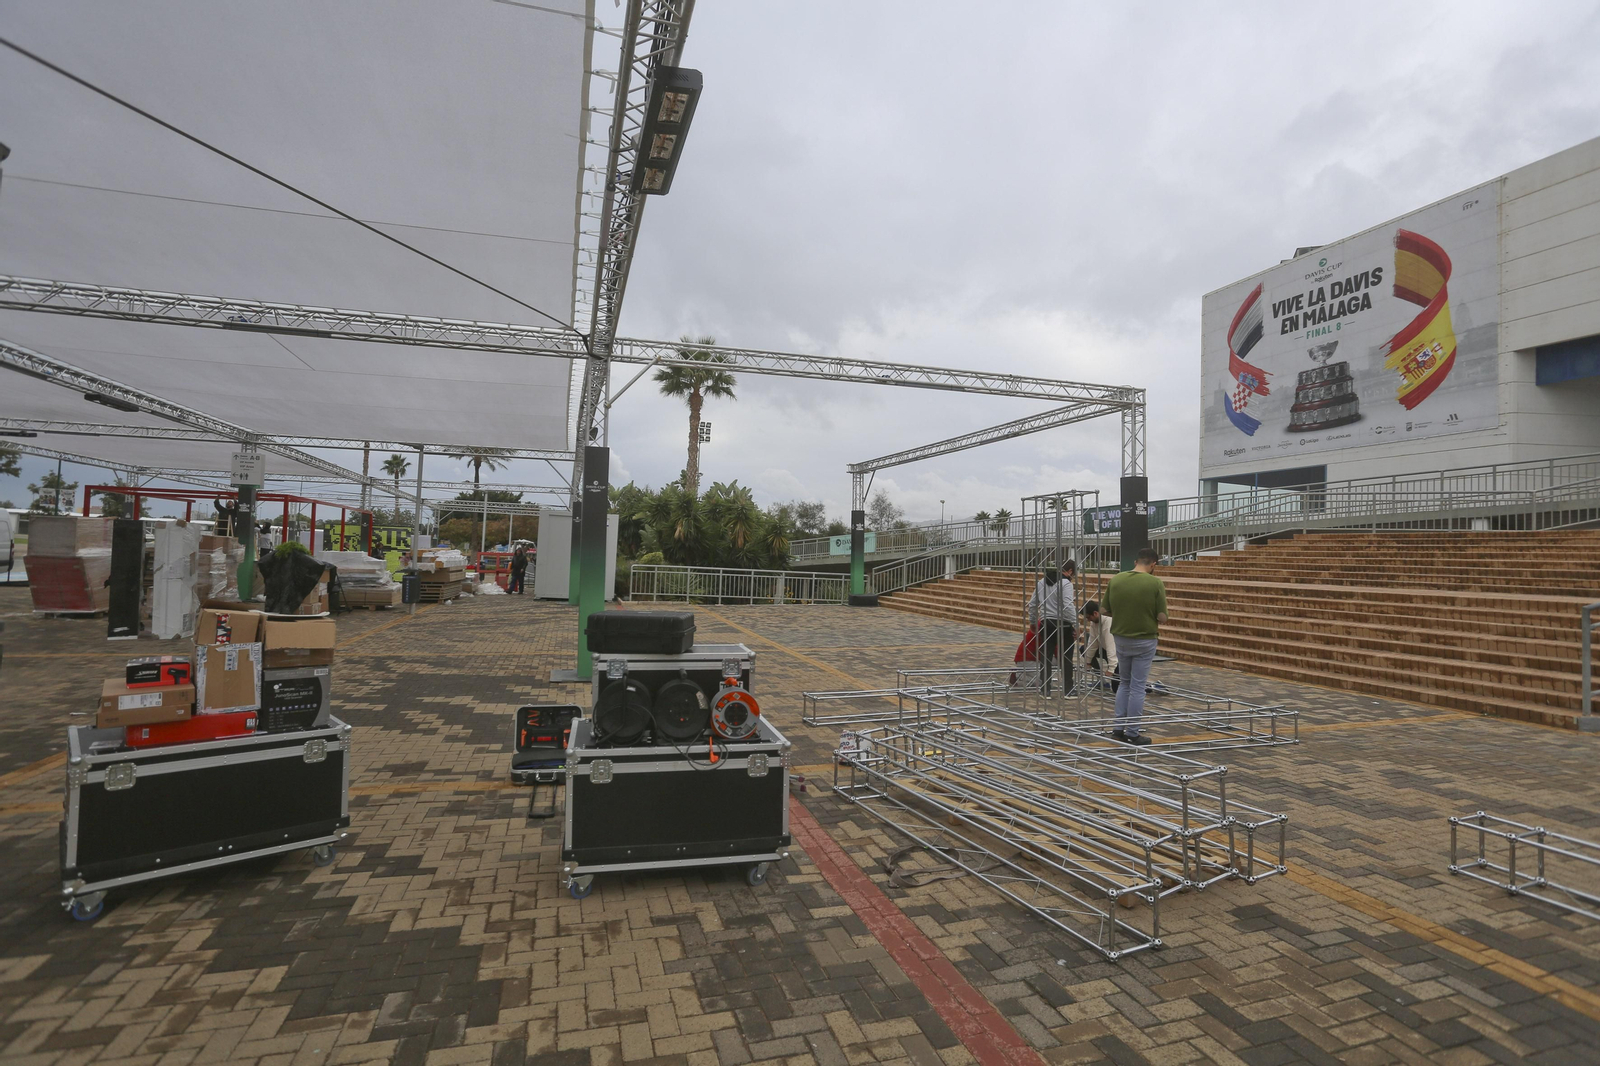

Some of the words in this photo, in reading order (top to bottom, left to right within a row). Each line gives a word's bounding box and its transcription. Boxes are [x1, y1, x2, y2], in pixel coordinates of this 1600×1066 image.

[1304, 268, 1325, 280] DAVIS
[1327, 262, 1343, 272] CUP
[1272, 293, 1304, 319] VIVE
[1308, 286, 1326, 307] LA
[1330, 267, 1383, 301] DAVIS
[1280, 314, 1299, 335] EN
[1303, 292, 1372, 329] MÁLAGA
[1306, 325, 1333, 340] FINAL
[1336, 322, 1342, 331] 8
[1224, 448, 1246, 457] Rakuten
[1102, 520, 1112, 529] OF
